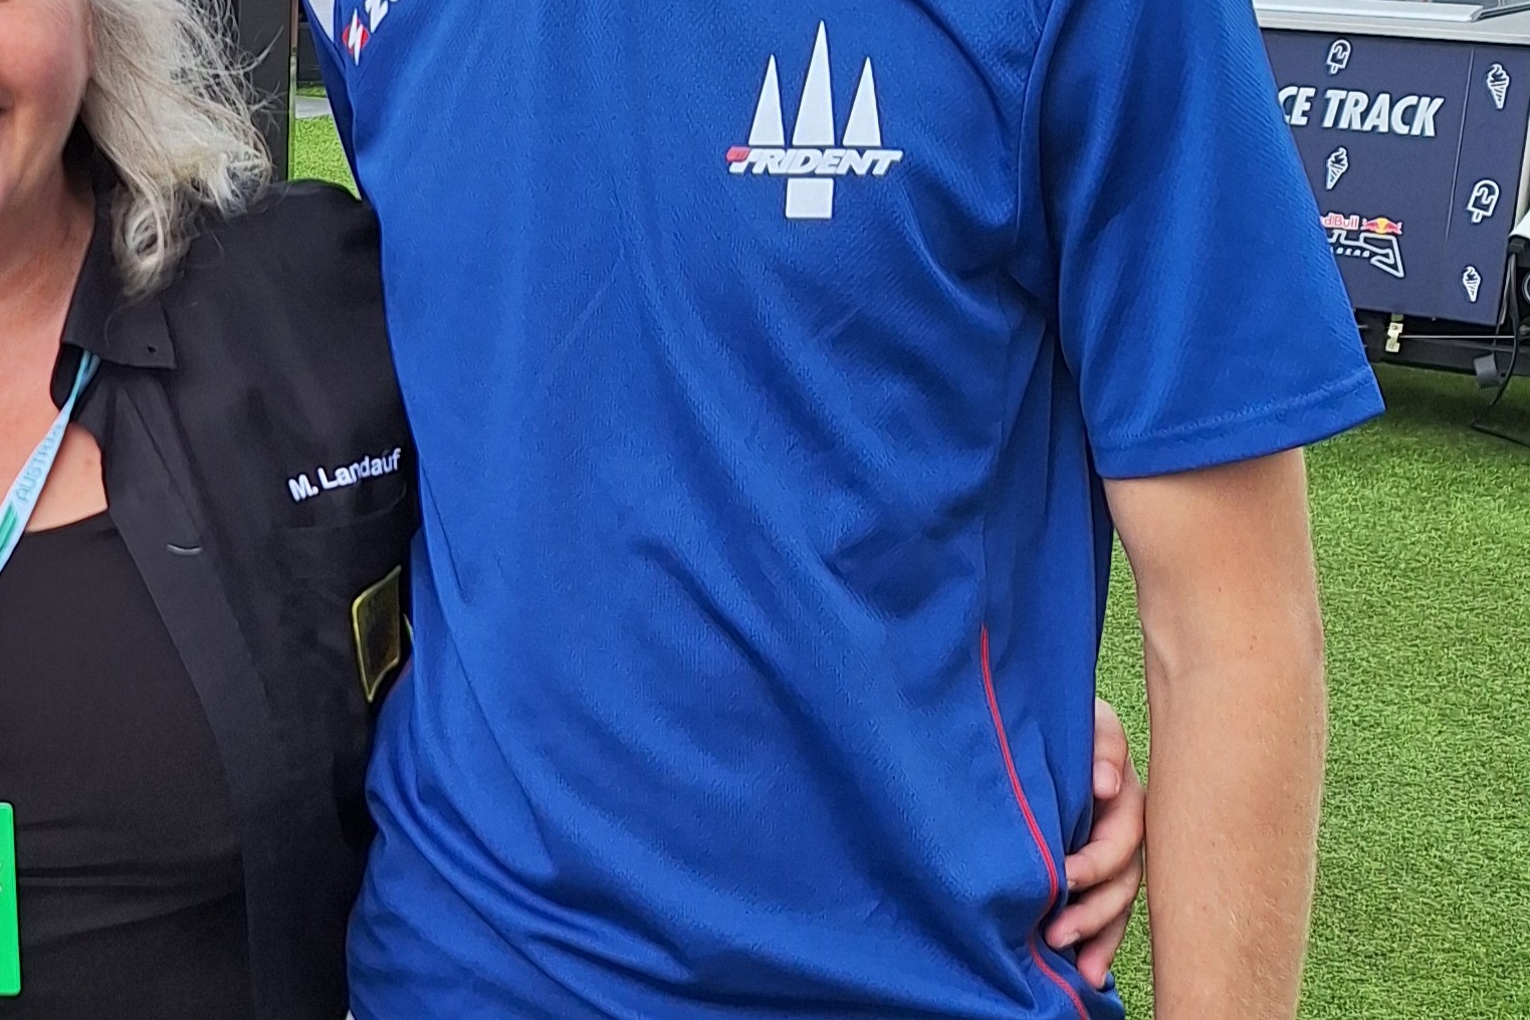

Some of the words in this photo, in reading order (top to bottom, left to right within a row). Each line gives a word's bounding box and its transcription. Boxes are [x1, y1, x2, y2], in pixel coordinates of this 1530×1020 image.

[1321, 88, 1445, 137] TRACK
[728, 147, 904, 176] TRIDENT
[15, 422, 64, 503] AUSTRIA
[288, 473, 320, 503] M.
[317, 447, 402, 492] Landauf
